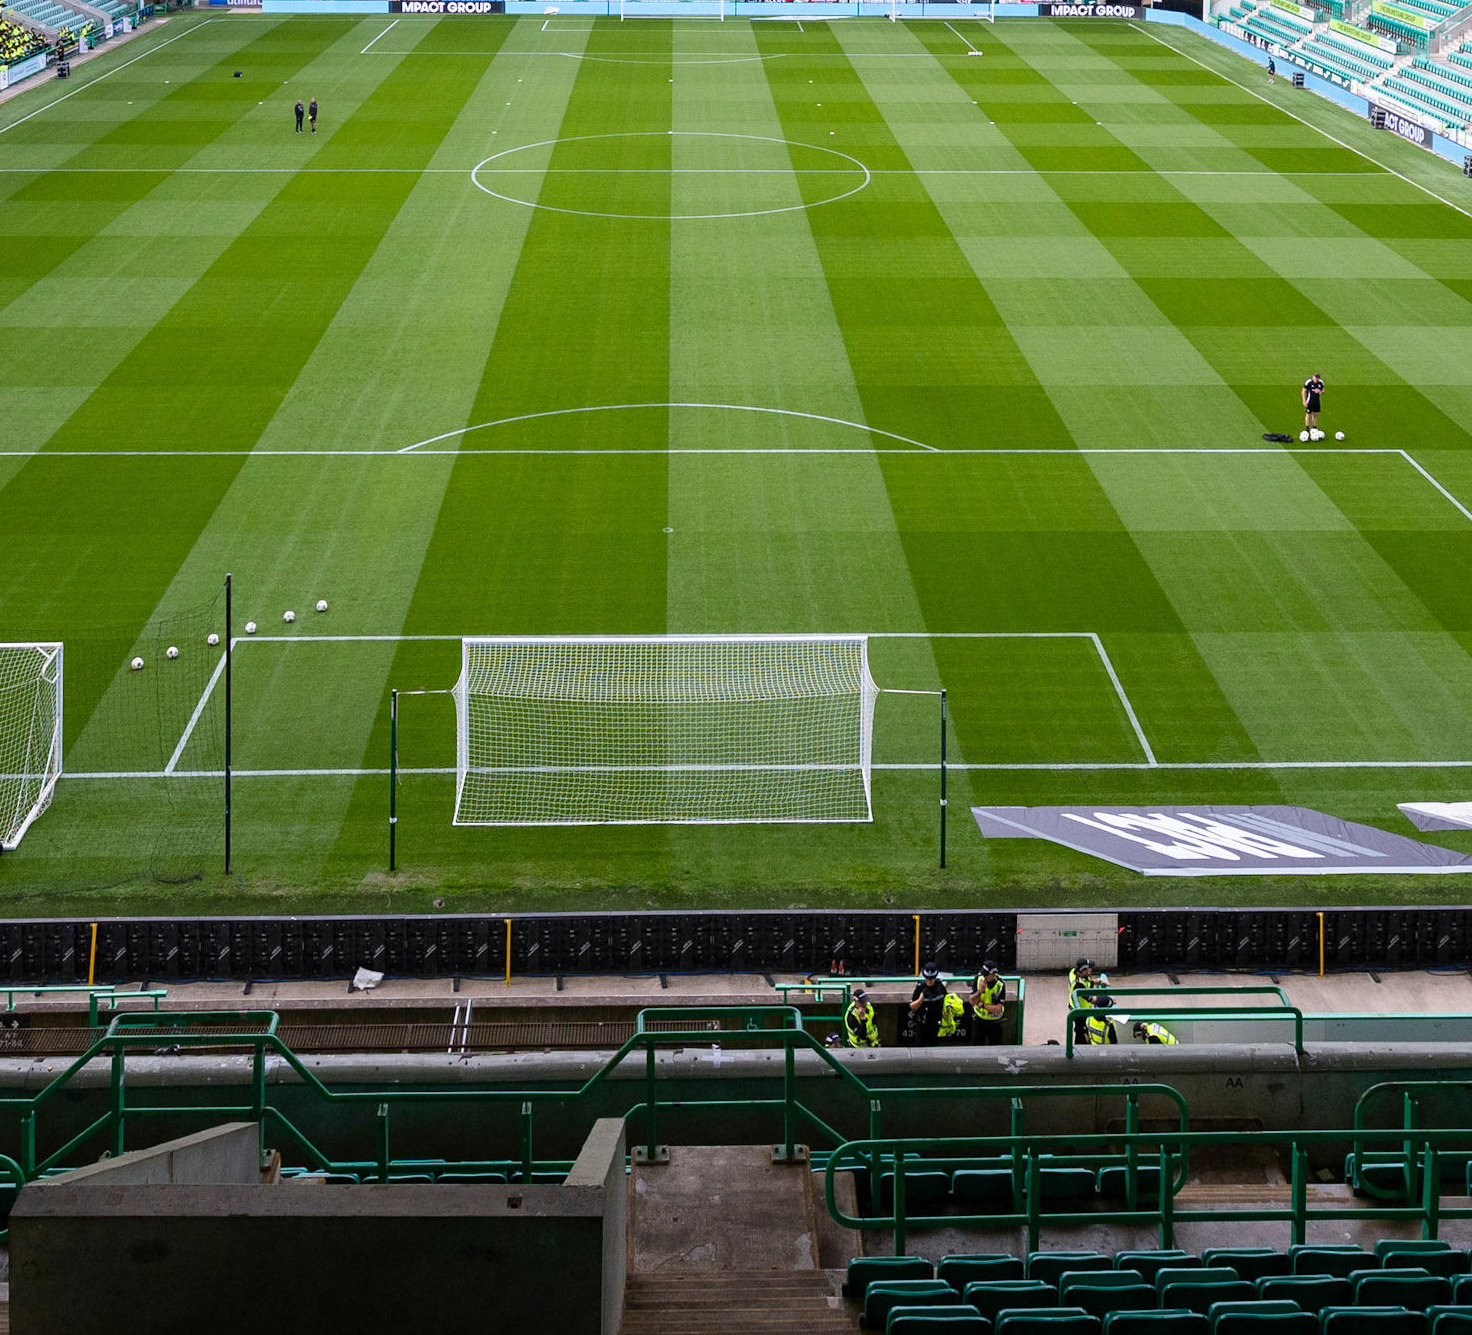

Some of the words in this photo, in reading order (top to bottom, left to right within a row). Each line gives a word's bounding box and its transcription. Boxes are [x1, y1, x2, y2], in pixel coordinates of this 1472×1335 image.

[401, 2, 445, 13] MPACT
[447, 2, 491, 13] GROUP
[1096, 6, 1135, 18] GROUP
[1399, 118, 1425, 144] GROUP
[1224, 1077, 1243, 1088] AA
